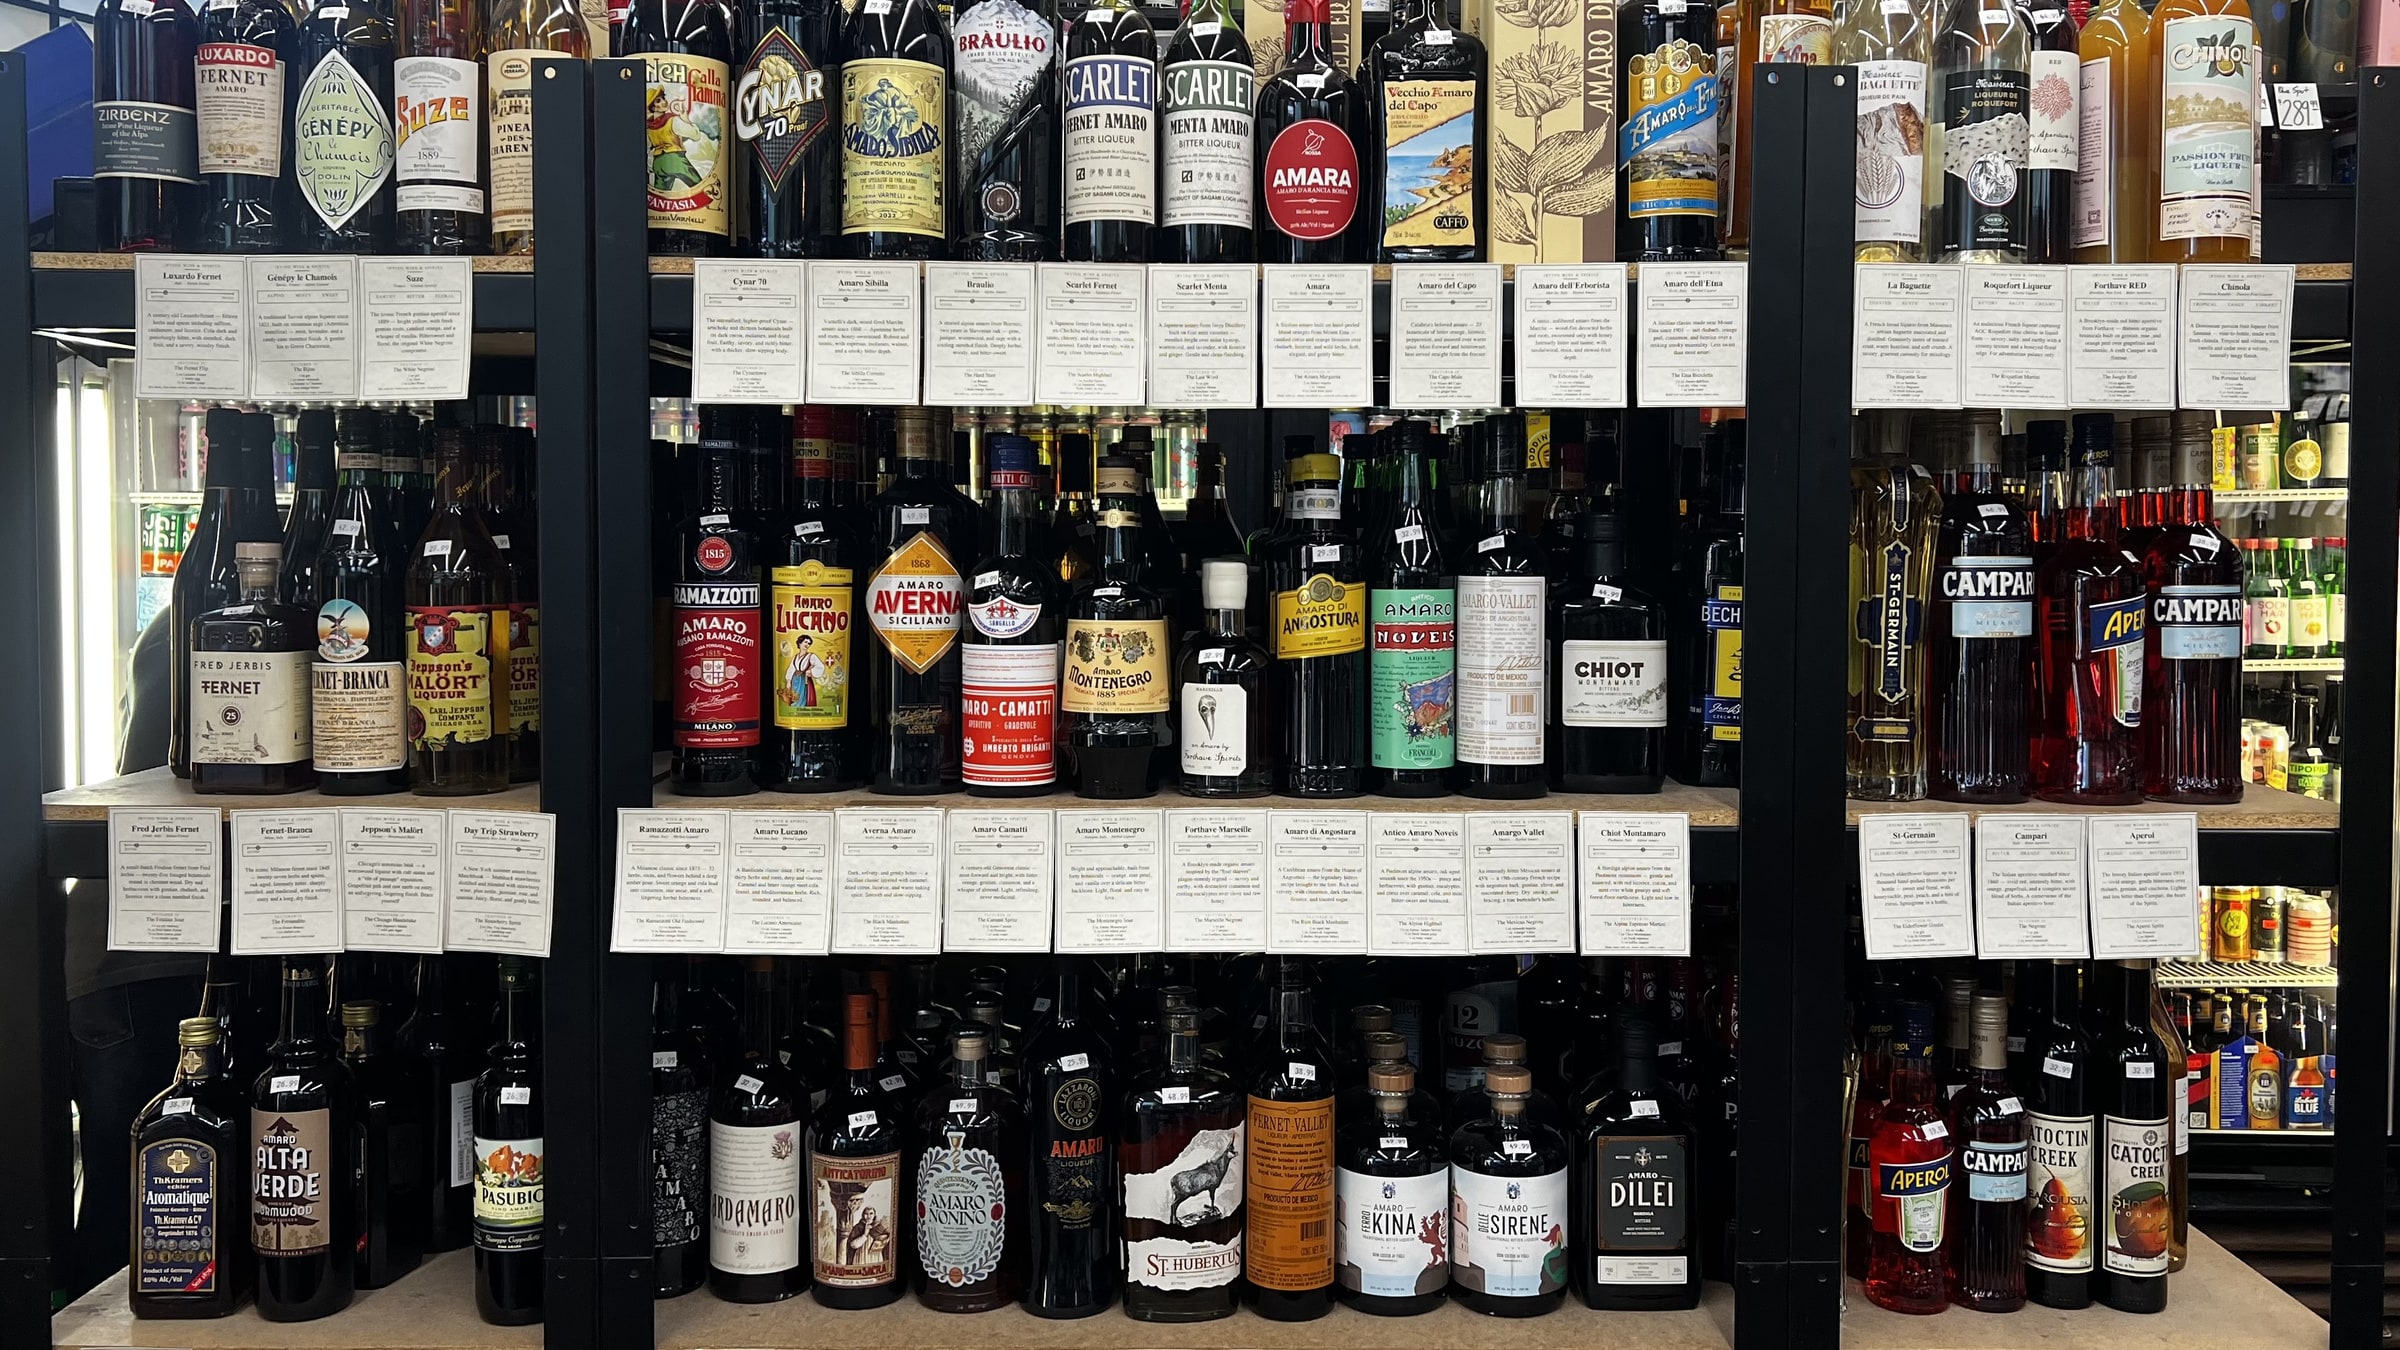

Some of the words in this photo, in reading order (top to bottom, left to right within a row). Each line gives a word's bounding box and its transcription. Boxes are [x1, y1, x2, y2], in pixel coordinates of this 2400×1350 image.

[200, 48, 270, 64] LUXARDO
[201, 69, 268, 86] FERNET
[1587, 31, 1614, 115] AMARO
[1065, 63, 1151, 102] SCARLET
[1166, 68, 1252, 108] SCARLET
[1861, 80, 1920, 91] BAGUETTE
[1387, 87, 1430, 98] Vecchio
[1432, 87, 1473, 97] Amaro
[312, 104, 359, 113] VERITABLE
[736, 70, 824, 141] CYNAR
[1390, 101, 1405, 110] del
[1408, 100, 1438, 112] Capo
[1972, 100, 2017, 108] ROQUEFORT
[99, 110, 170, 124] ZIRBENZ
[397, 96, 469, 150] Suze
[1067, 114, 1100, 134] FERNET
[1105, 113, 1146, 131] AMARO
[302, 117, 374, 139] GÉNÉPY
[765, 118, 787, 141] 70
[1170, 118, 1207, 135] MENTA
[1212, 118, 1248, 137] AMARO
[1074, 135, 1095, 146] BITTER
[1098, 135, 1135, 144] LIQUEUR
[1179, 139, 1203, 148] BITTER
[1207, 139, 1241, 149] LIQUEUR
[304, 141, 370, 163] Chamois
[418, 152, 439, 160] 1889
[2172, 153, 2226, 163] PASSION
[2194, 161, 2240, 170] LIQUEUR
[1273, 168, 1352, 188] AMARA
[1435, 217, 1467, 228] CAFFO
[268, 275, 294, 284] Génépy
[733, 278, 756, 287] Cynar
[1457, 282, 1476, 290] Capo
[1900, 282, 1930, 292] Baguette
[1984, 282, 2020, 292] Roquefort
[2023, 283, 2052, 293] Liqueur
[145, 513, 176, 531] Jai
[1401, 528, 1421, 537] 32.99
[705, 549, 725, 559] 1815
[1317, 549, 1337, 558] 29.99
[898, 581, 943, 590] AMARO
[674, 587, 758, 604] RAMAZZOTTI
[794, 595, 832, 609] AMARO
[874, 590, 968, 615] AVERNA
[1296, 604, 1334, 615] AMARO
[1385, 604, 1452, 617] AMARO
[775, 604, 848, 633] LUCANO
[889, 616, 950, 625] SICILIANO
[1283, 612, 1359, 635] ANGOSTURA
[1886, 573, 1901, 667] ST-GERMAIN
[682, 618, 747, 635] AMARO
[1376, 630, 1455, 643] NOVEIS
[194, 661, 223, 669] FRED
[229, 662, 272, 670] JERBIS
[411, 660, 472, 674] Jeppson's
[1093, 667, 1121, 675] AMARO
[1574, 662, 1644, 678] CHIOT
[1069, 666, 1151, 690] MONTENEGRO
[202, 681, 261, 695] FERNET
[414, 691, 466, 700] LIQUEUR
[694, 722, 732, 730] MILANO
[361, 826, 393, 836] Jeppson's
[397, 827, 423, 835] Malört
[1102, 827, 1144, 837] Montenegro
[1320, 829, 1356, 839] Angostura
[1493, 830, 1521, 840] Amargo
[2015, 833, 2047, 842] Campari
[2130, 831, 2155, 841] Aperol
[2050, 1063, 2071, 1074] 32.99
[276, 1079, 298, 1089] 26.99
[741, 1079, 760, 1090] 32.99
[1059, 1083, 1098, 1103] LAZZARONI
[2294, 1103, 2319, 1113] BLUE
[854, 1115, 874, 1123] 42.99
[1061, 1109, 1096, 1126] LIQUORI
[264, 1135, 296, 1144] AMARO
[1051, 1136, 1102, 1158] AMARO
[257, 1147, 309, 1170] ALTA
[2031, 1146, 2077, 1167] CREEK
[1891, 1167, 1949, 1190] APEROL
[2131, 1166, 2164, 1178] CREEK
[253, 1173, 320, 1198] VERDE
[146, 1191, 210, 1206] Aromatique
[483, 1188, 543, 1205] PASUBIO
[930, 1194, 985, 1209] AMARO
[1611, 1182, 1673, 1208] DILEI
[713, 1194, 794, 1227] ARDAMARO
[1373, 1204, 1403, 1212] AMARO
[1498, 1204, 1528, 1212] AMARO
[929, 1211, 986, 1225] NONINO
[1362, 1211, 1370, 1232] FERRO
[1372, 1213, 1416, 1236] KINA
[1478, 1213, 1489, 1232] DELLE
[1491, 1214, 1548, 1235] SIRENE
[1148, 1253, 1168, 1276] ST.
[1173, 1244, 1240, 1271] HUBERTUS
